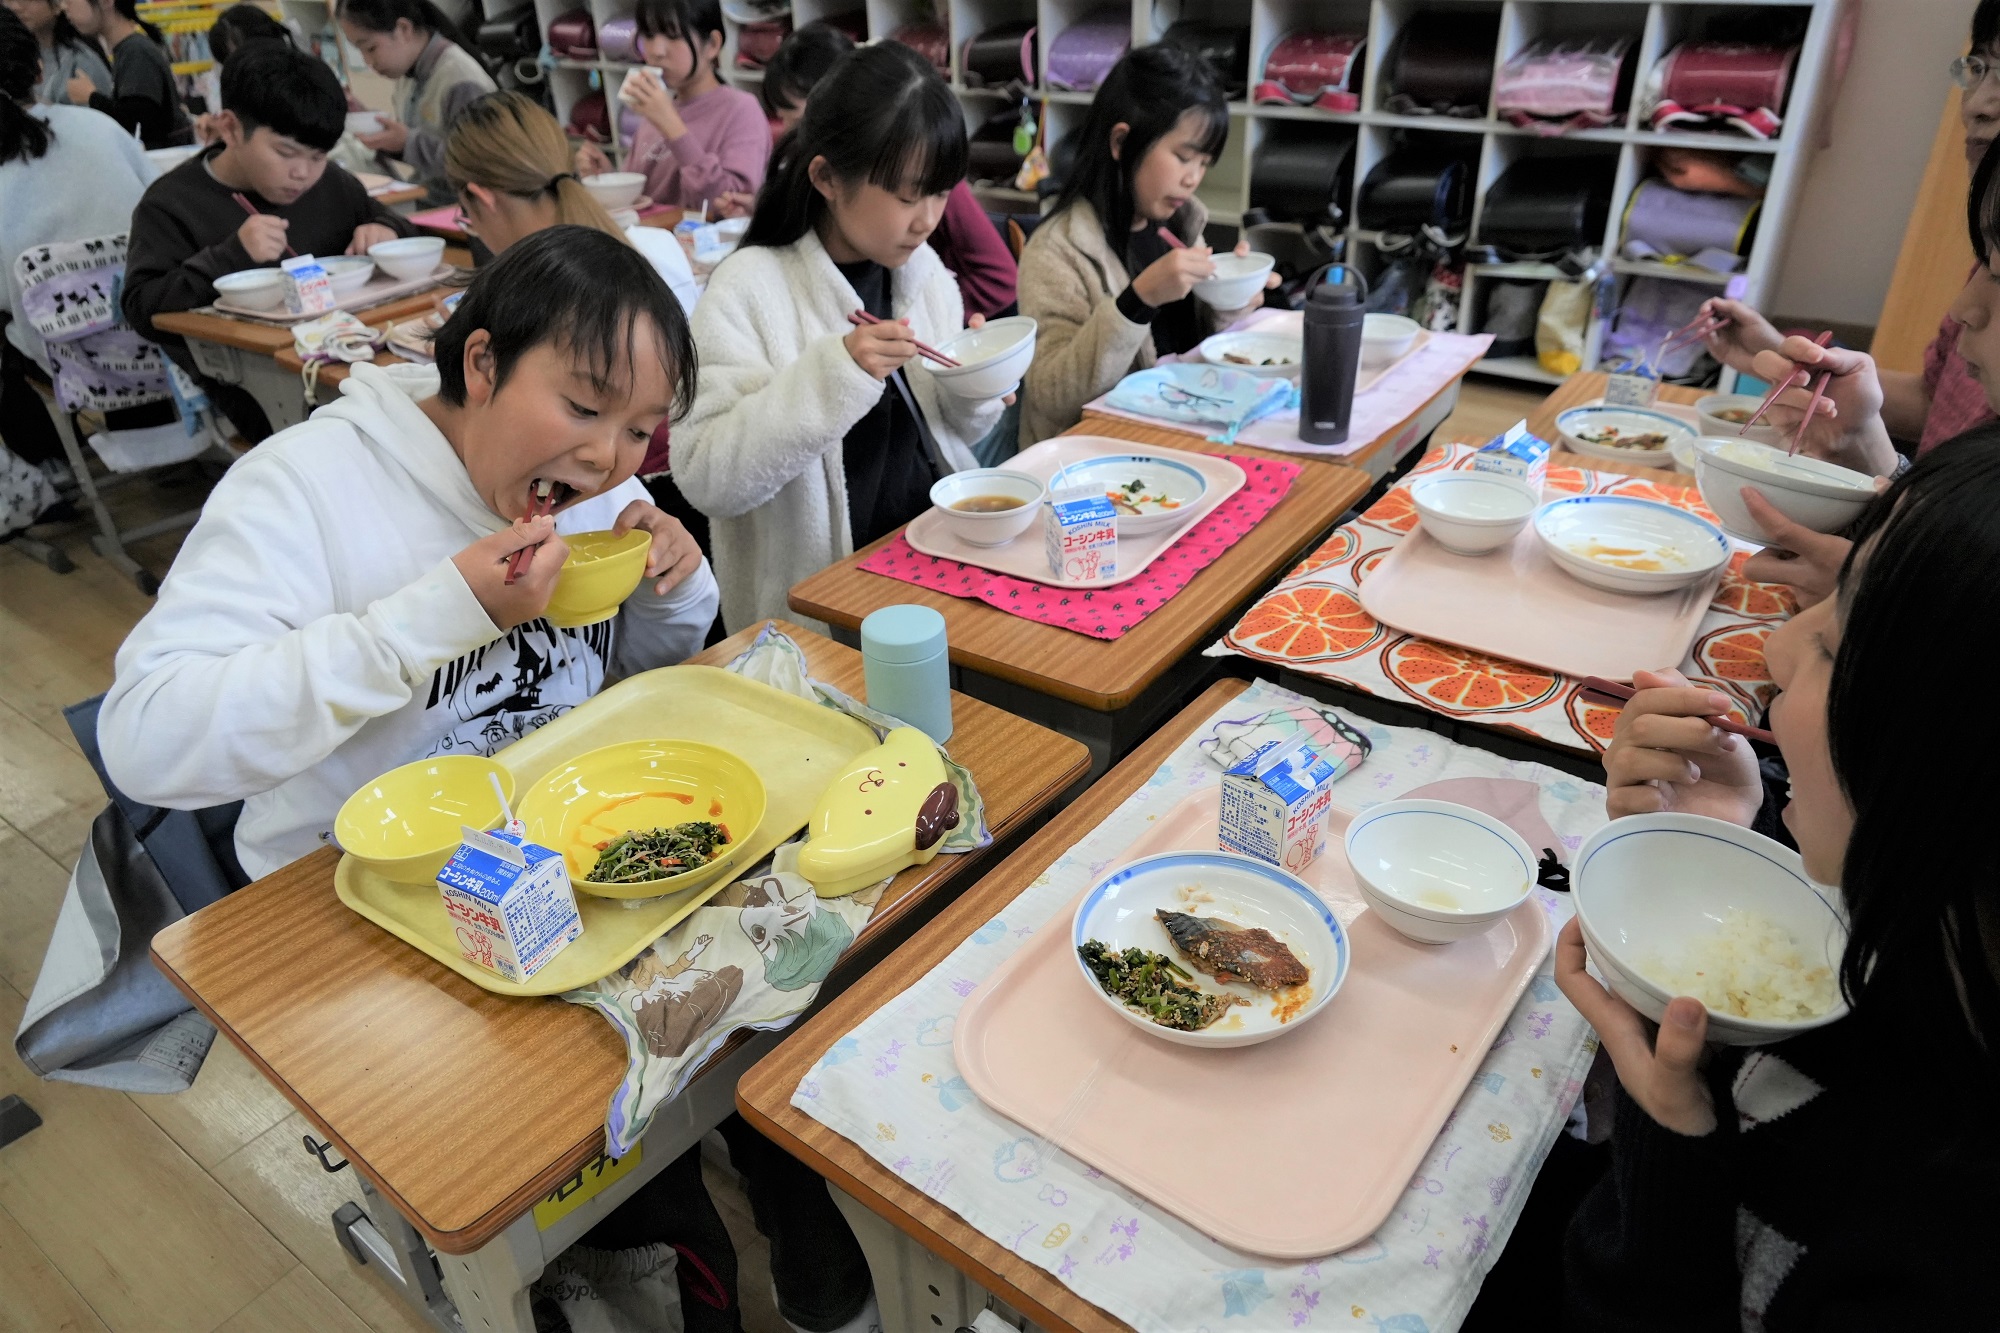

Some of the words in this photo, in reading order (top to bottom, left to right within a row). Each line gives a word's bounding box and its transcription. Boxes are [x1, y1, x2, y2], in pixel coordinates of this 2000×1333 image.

[1060, 511, 1097, 524] コーシン牛乳
[1068, 521, 1093, 535] KOSHIN
[1063, 528, 1116, 548] コーシン牛乳
[1287, 789, 1331, 833] コーシン牛乳
[1293, 790, 1315, 815] KOSHIN
[1317, 782, 1331, 793] MILK
[439, 867, 484, 893] コーシン牛乳
[442, 895, 504, 934] コーシン牛乳
[445, 889, 472, 902] KOSHIN
[474, 898, 494, 916] MILK
